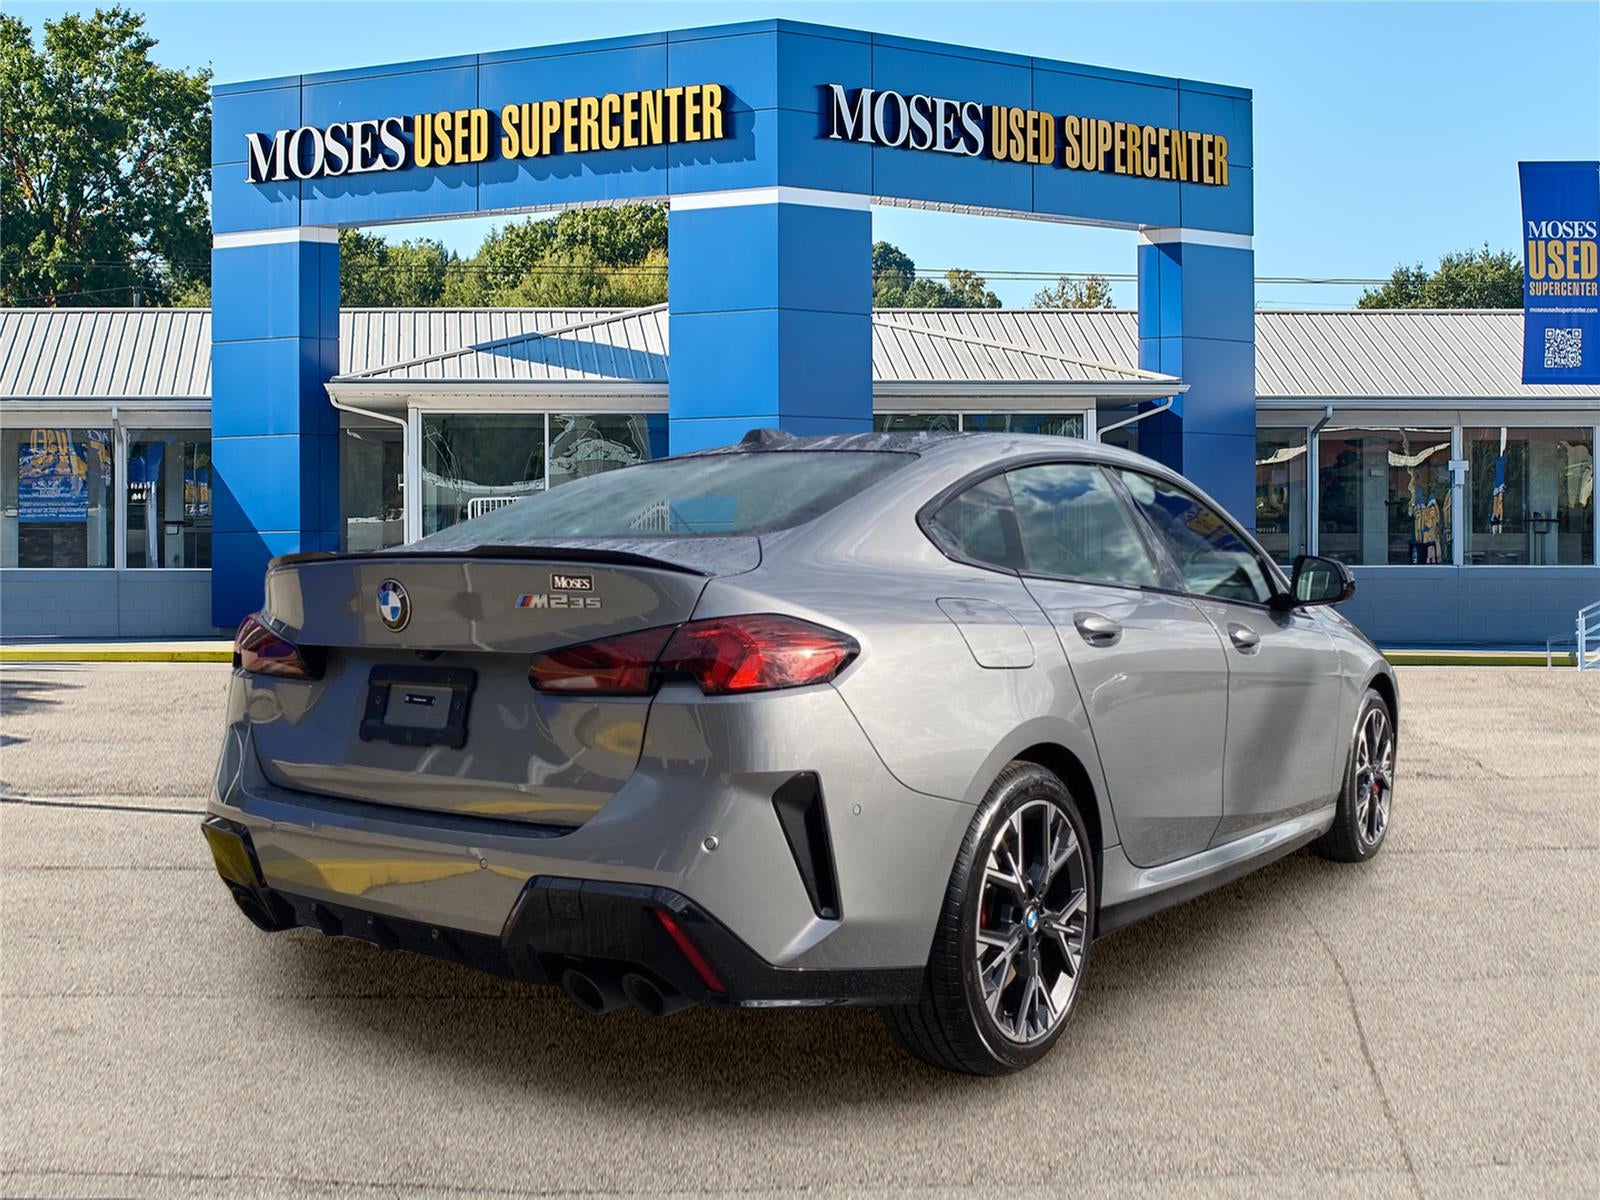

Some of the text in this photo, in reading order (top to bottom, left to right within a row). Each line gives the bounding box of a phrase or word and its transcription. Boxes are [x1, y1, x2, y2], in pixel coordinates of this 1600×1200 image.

[244, 83, 724, 184] MOSES USED SUPERCENTER
[828, 83, 1230, 187] MOSES USED SUPERCENTER
[1528, 220, 1597, 239] MOSES
[1528, 240, 1598, 280] USED
[1529, 281, 1598, 296] SUPERCENTER
